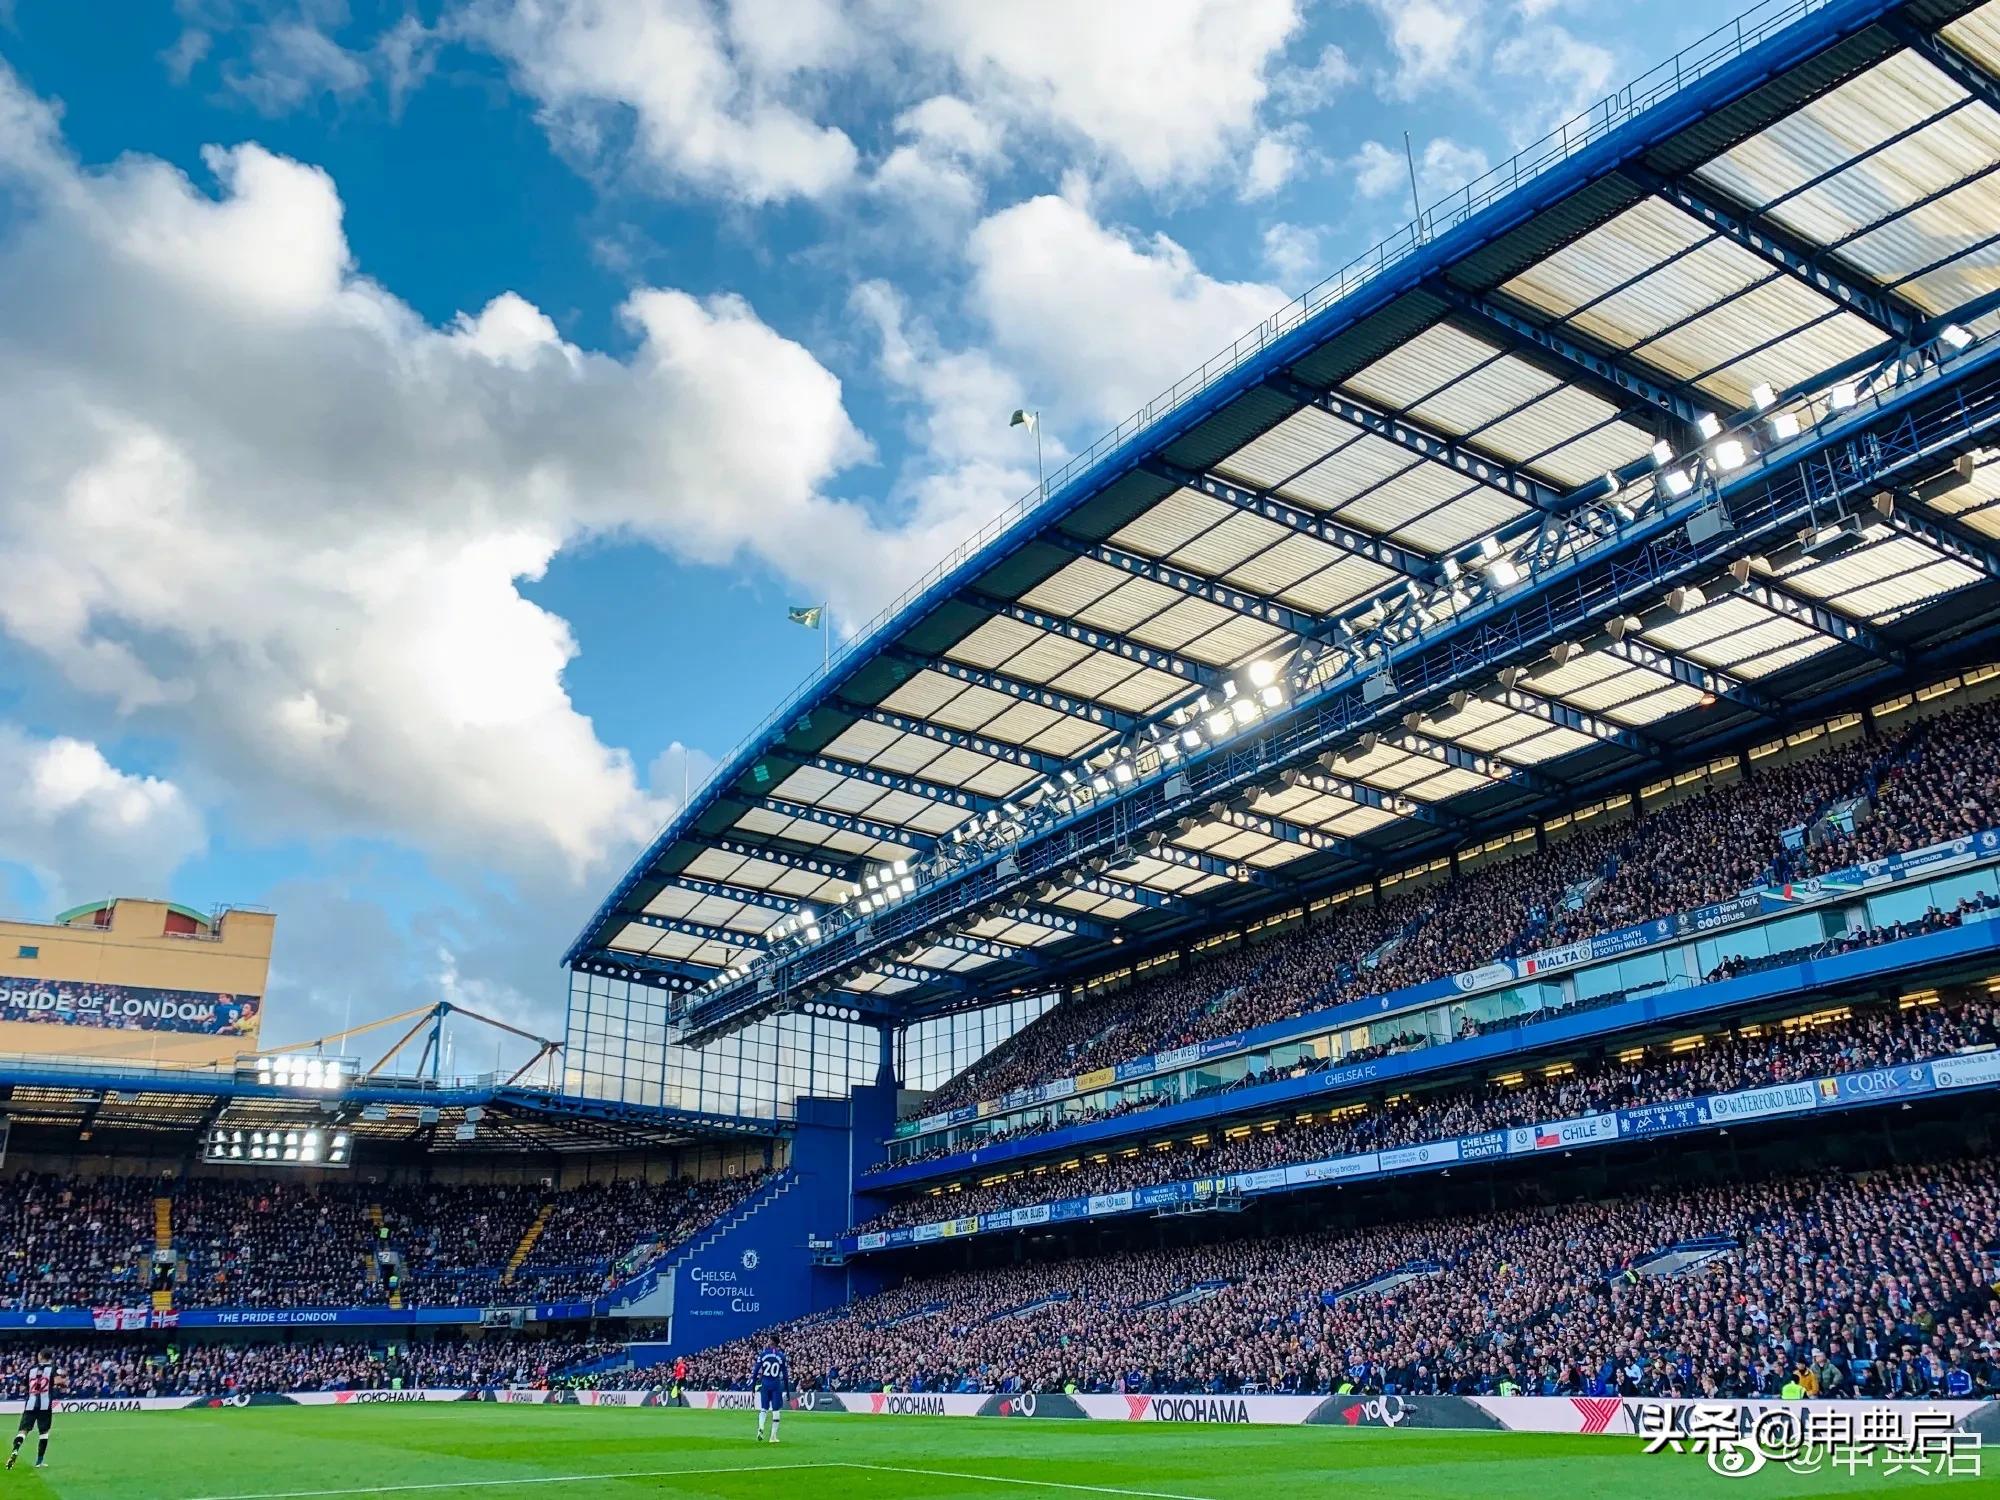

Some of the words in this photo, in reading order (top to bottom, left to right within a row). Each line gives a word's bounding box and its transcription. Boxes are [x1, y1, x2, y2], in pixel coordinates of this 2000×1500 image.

[1889, 861, 1904, 872] BLUE
[1909, 858, 1920, 867] THE
[1919, 853, 1943, 864] COLOUR
[1719, 902, 1738, 915] New
[1738, 896, 1759, 909] York
[1721, 911, 1746, 924] Blues
[1623, 930, 1642, 942] BATH
[1541, 944, 1575, 957] SUPPORTERS
[1600, 942, 1624, 956] SOUTH
[1624, 936, 1648, 949] WALES
[1537, 951, 1579, 970] MALTA
[77, 997, 104, 1010] OF
[109, 998, 214, 1021] LONDON
[1156, 1051, 1179, 1066] SOUTH
[1181, 1044, 1199, 1058] WEST
[1325, 1069, 1364, 1086] CHELSEA
[1365, 1066, 1377, 1078] FC
[1846, 1070, 1899, 1093] CORK
[1727, 1090, 1784, 1114] WATERFORD
[1784, 1086, 1813, 1106] BLUES
[1629, 1108, 1653, 1119] DESERT
[1653, 1105, 1674, 1115] TEXAS
[1674, 1101, 1695, 1112] BLUES
[1562, 1124, 1597, 1140] CHILE
[1460, 1133, 1503, 1149] CHELSEA
[1462, 1144, 1503, 1159] CROATIA
[1143, 1191, 1178, 1205] VANCOUVER
[987, 1211, 1011, 1222] ADELAIDE
[1016, 1208, 1029, 1220] YORK
[1030, 1206, 1045, 1219] BLUES
[955, 1223, 975, 1234] BLUES
[987, 1219, 1011, 1230] CHELSEA
[691, 1267, 737, 1281] CHELSEA
[700, 1282, 755, 1297] FOOTBALL
[731, 1298, 760, 1313] CLUB
[217, 1313, 239, 1323] THE
[241, 1312, 275, 1322] PRIDE
[277, 1312, 288, 1322] OF
[290, 1312, 337, 1322] LONDON
[762, 1361, 780, 1377] 20
[355, 1392, 426, 1403] YOKOHAMA
[716, 1394, 756, 1410] YOKOHAMA
[61, 1401, 141, 1413] YOKOHAMA
[886, 1396, 946, 1416] YOKOHAMA
[1151, 1398, 1250, 1423] YOKOHAMA
